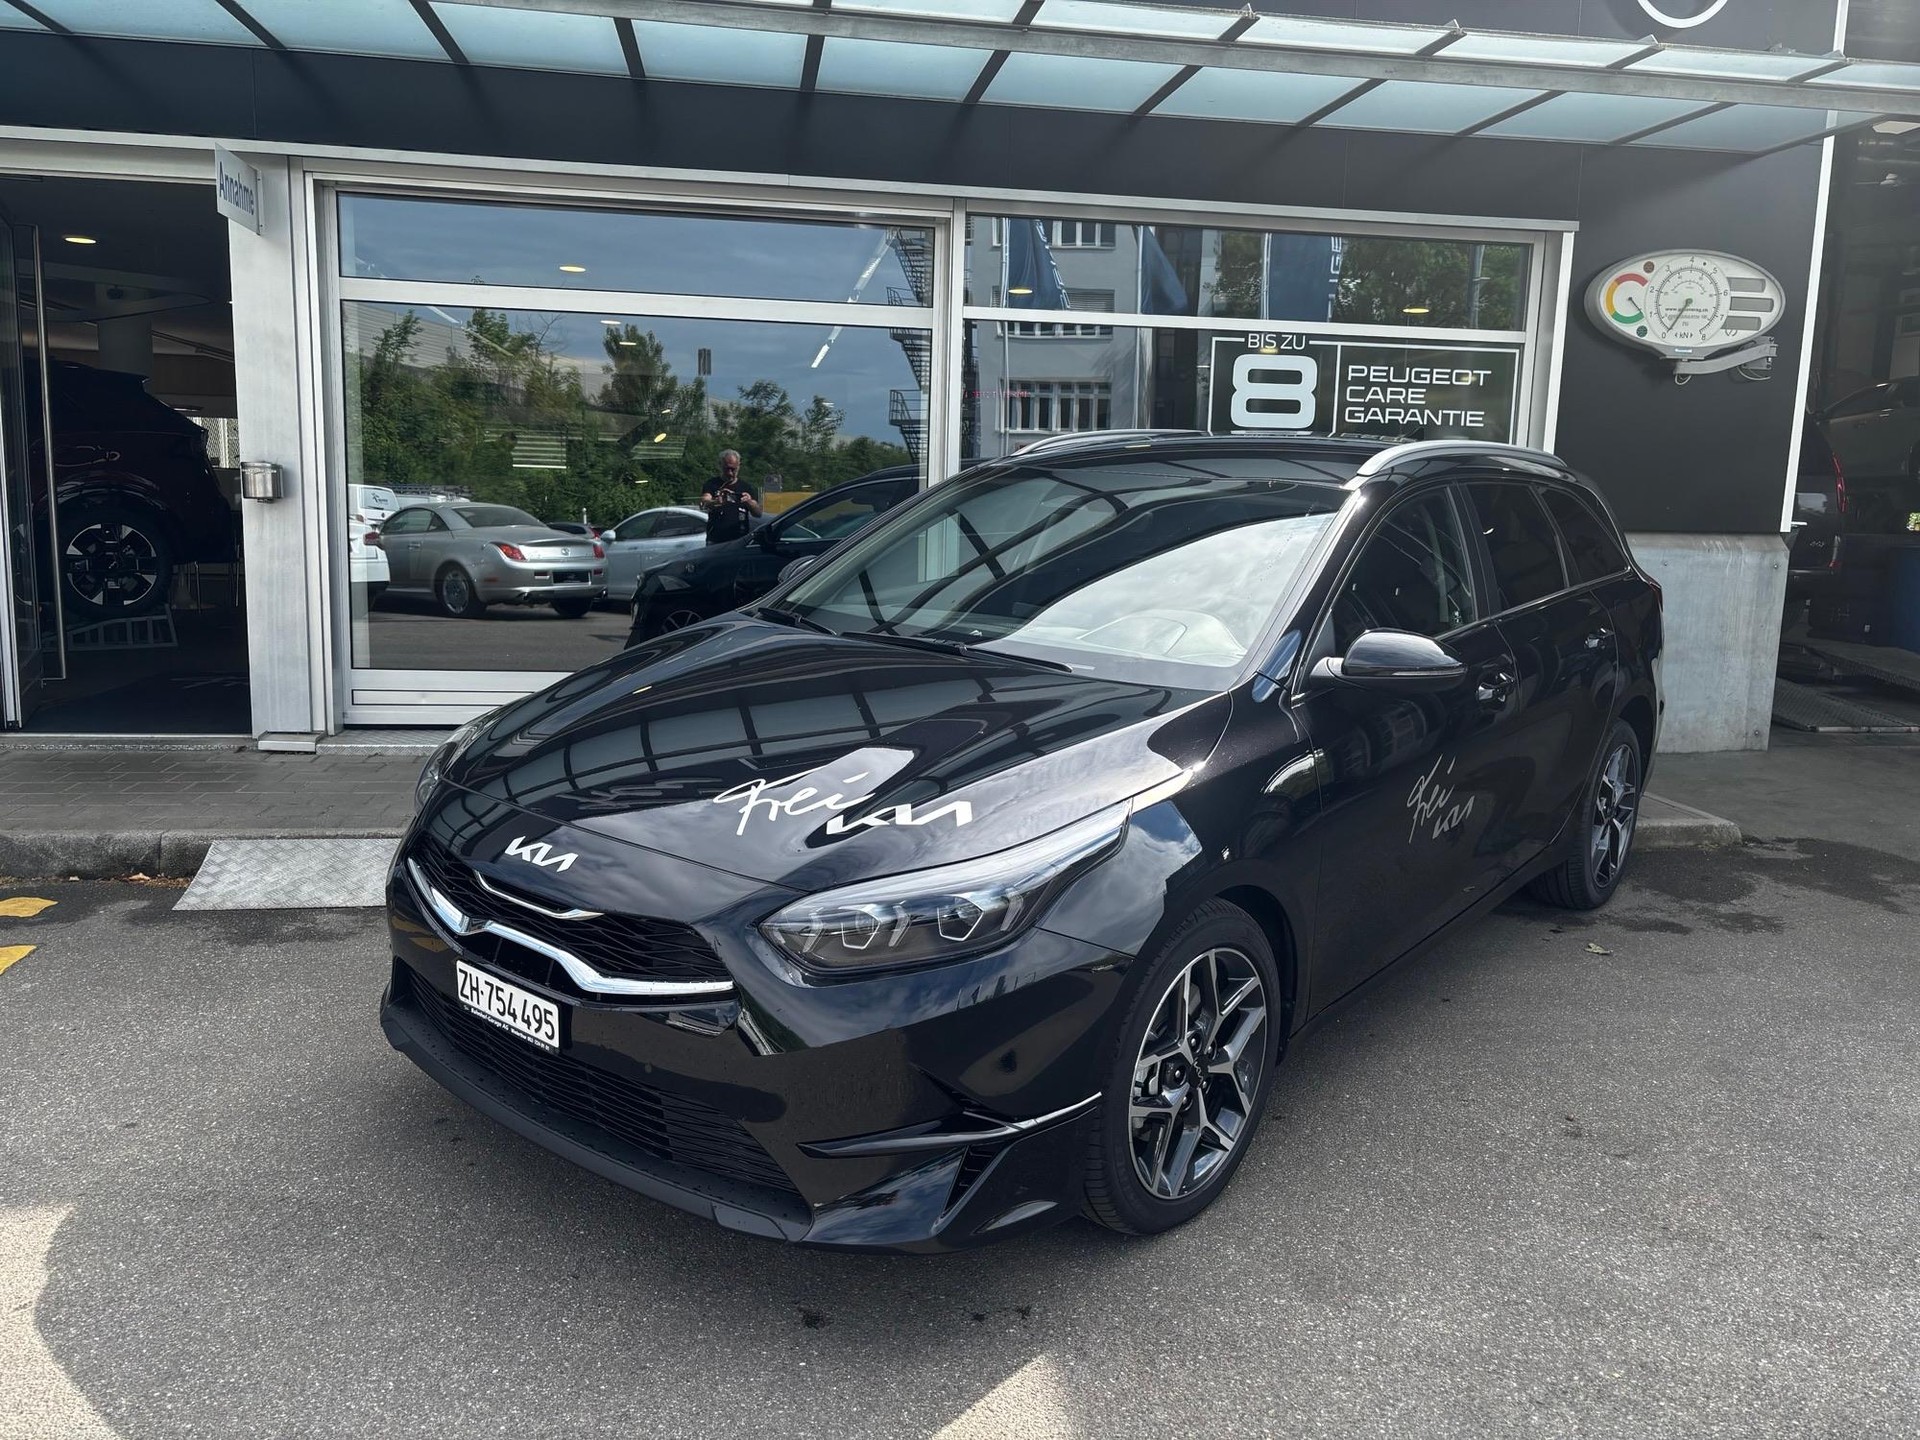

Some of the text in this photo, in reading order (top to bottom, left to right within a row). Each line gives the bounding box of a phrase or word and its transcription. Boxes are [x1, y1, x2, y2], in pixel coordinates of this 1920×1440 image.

[219, 161, 254, 215] Annahme
[1247, 333, 1306, 350] BIS ZU
[1347, 364, 1492, 386] PEUGEOT
[1230, 353, 1318, 429] 8
[1346, 386, 1427, 405] CARE
[1344, 407, 1485, 427] GARANTIE
[504, 835, 579, 873] KIA
